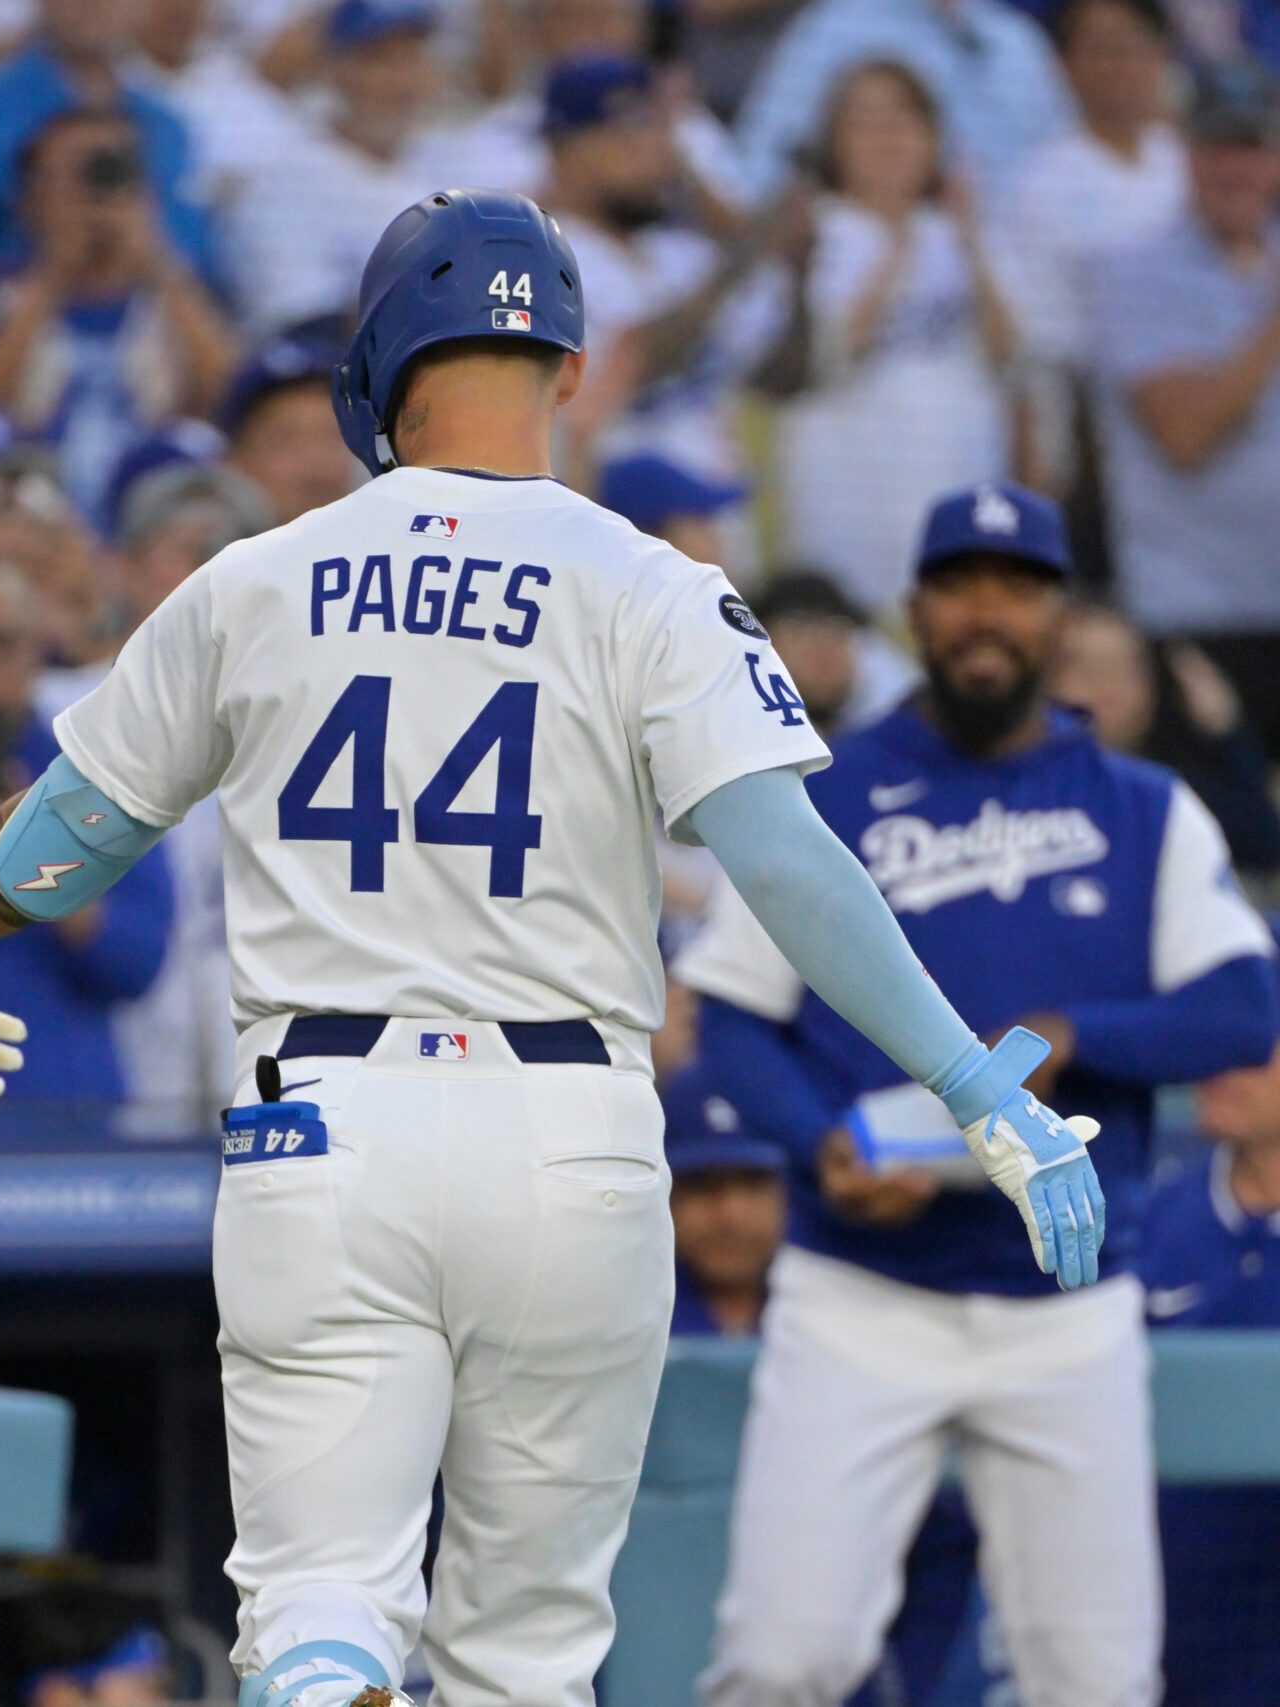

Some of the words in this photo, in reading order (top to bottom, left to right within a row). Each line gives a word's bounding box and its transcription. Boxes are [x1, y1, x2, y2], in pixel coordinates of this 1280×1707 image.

[488, 270, 533, 306] 44
[310, 554, 552, 649] PAGES
[744, 651, 806, 727] LA
[277, 674, 543, 899] 44
[222, 1135, 255, 1155] BEN
[264, 1128, 305, 1153] 44
